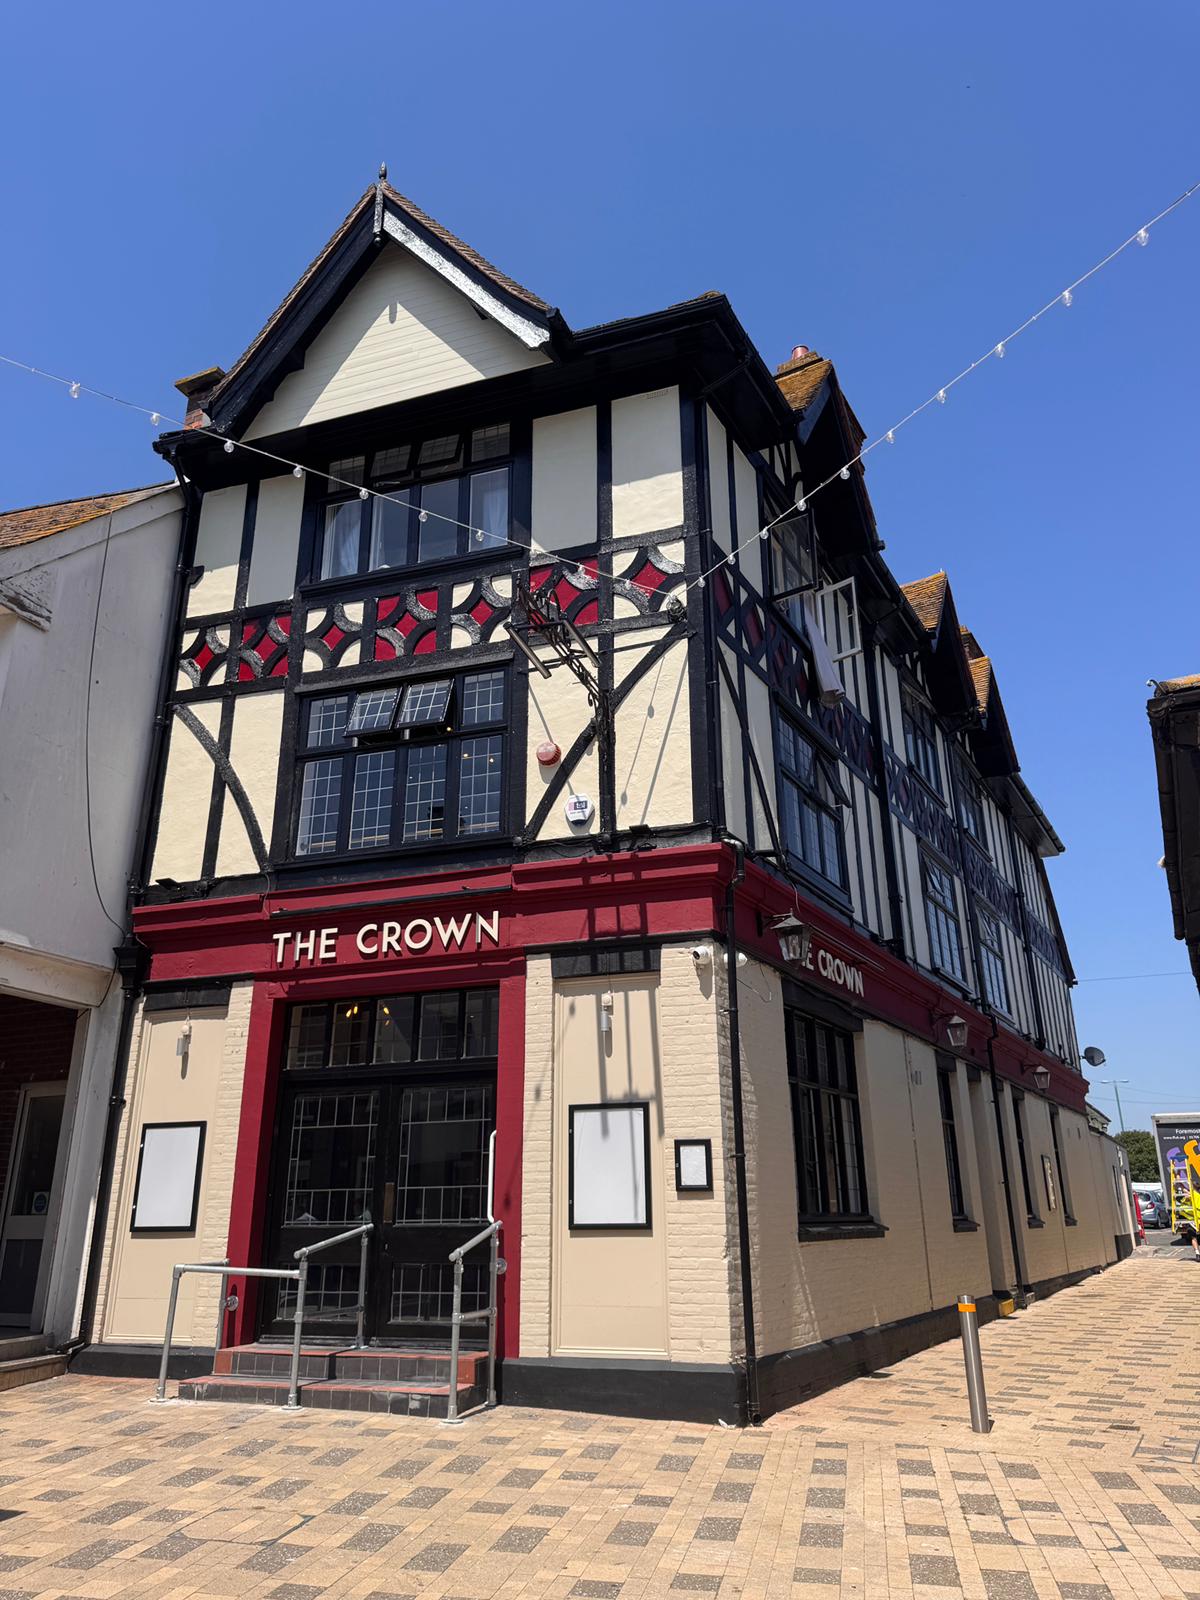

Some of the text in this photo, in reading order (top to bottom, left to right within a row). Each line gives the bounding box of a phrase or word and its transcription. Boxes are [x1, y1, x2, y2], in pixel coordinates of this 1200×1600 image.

[272, 910, 500, 964] THE CROWN
[817, 948, 865, 998] CROWN
